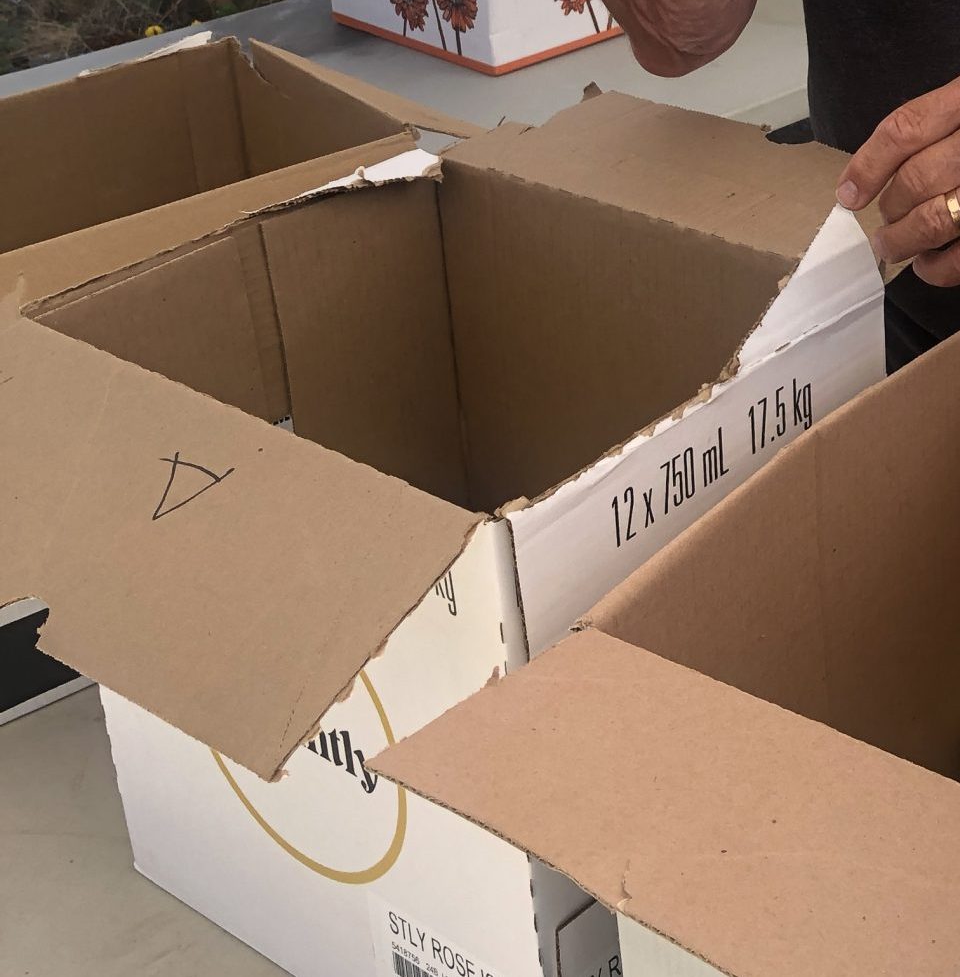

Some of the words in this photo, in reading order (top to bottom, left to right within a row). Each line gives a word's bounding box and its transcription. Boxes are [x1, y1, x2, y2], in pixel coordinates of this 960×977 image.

[611, 486, 637, 548] 12
[642, 487, 655, 528] x
[659, 446, 696, 516] 750
[702, 426, 730, 488] mL
[748, 385, 786, 455] 17.5
[792, 377, 813, 431] kg
[388, 910, 426, 953] STLY
